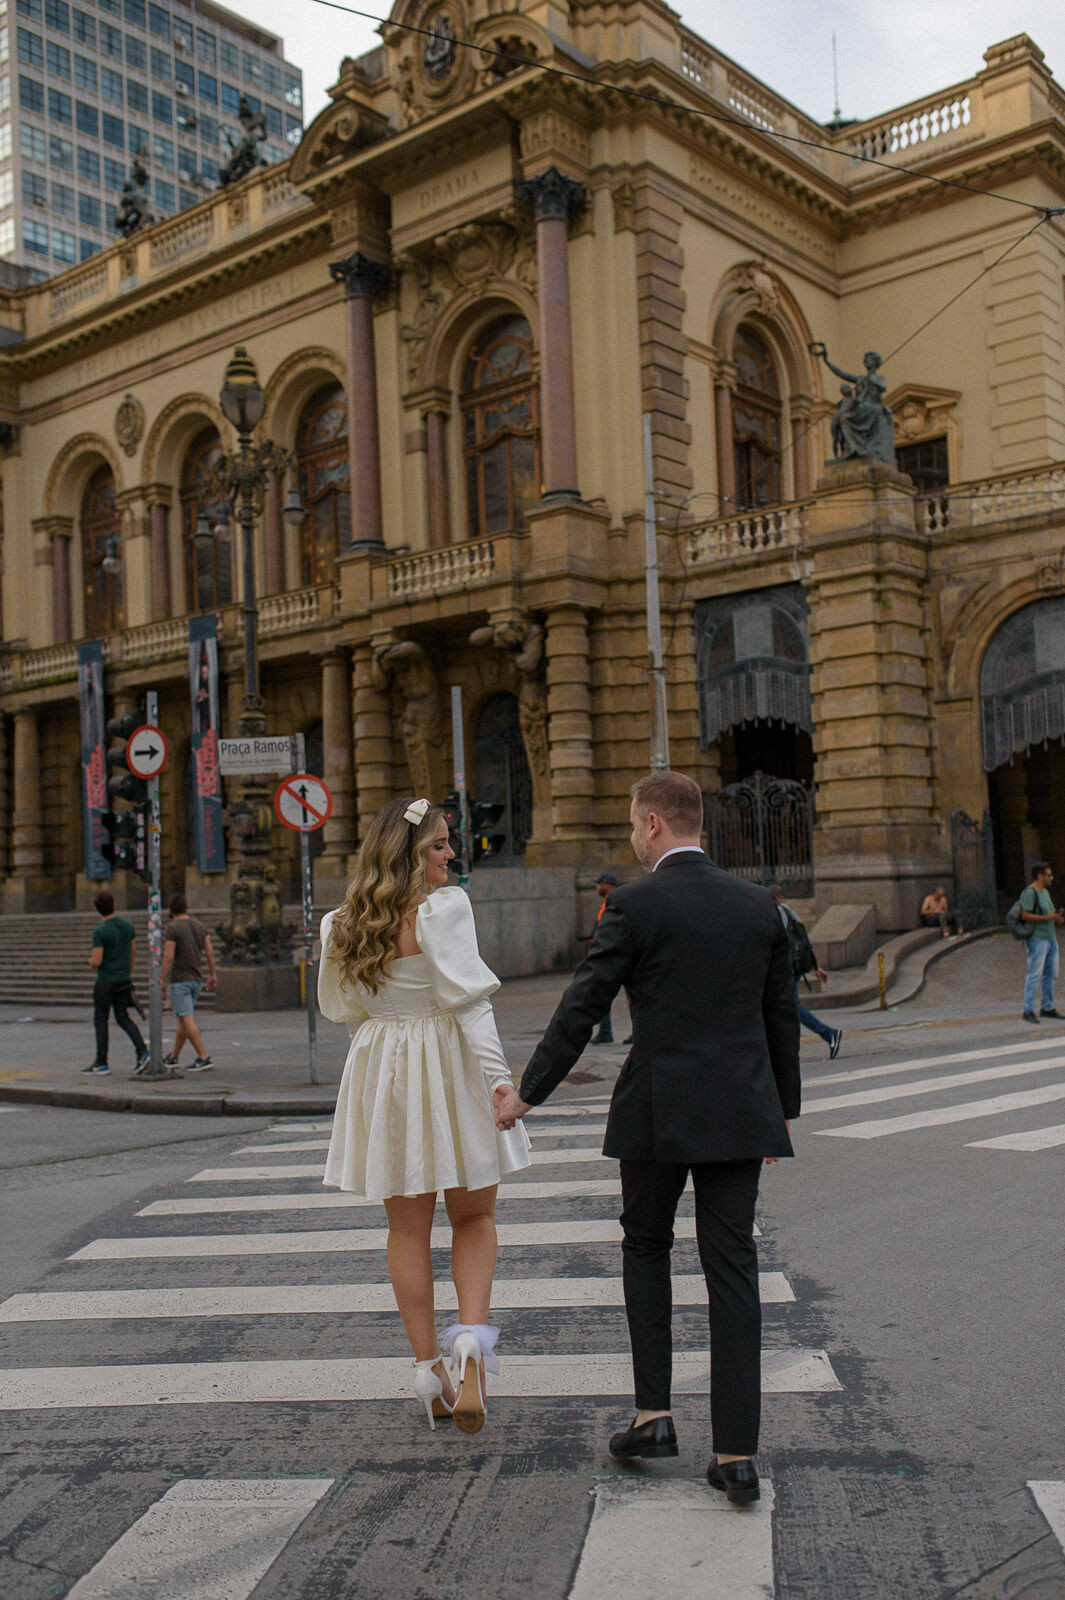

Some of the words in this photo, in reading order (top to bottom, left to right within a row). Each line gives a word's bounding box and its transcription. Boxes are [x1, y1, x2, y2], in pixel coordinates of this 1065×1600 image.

[420, 169, 480, 207] DRAMA
[221, 742, 250, 758] Praça
[254, 741, 290, 754] Ramos
